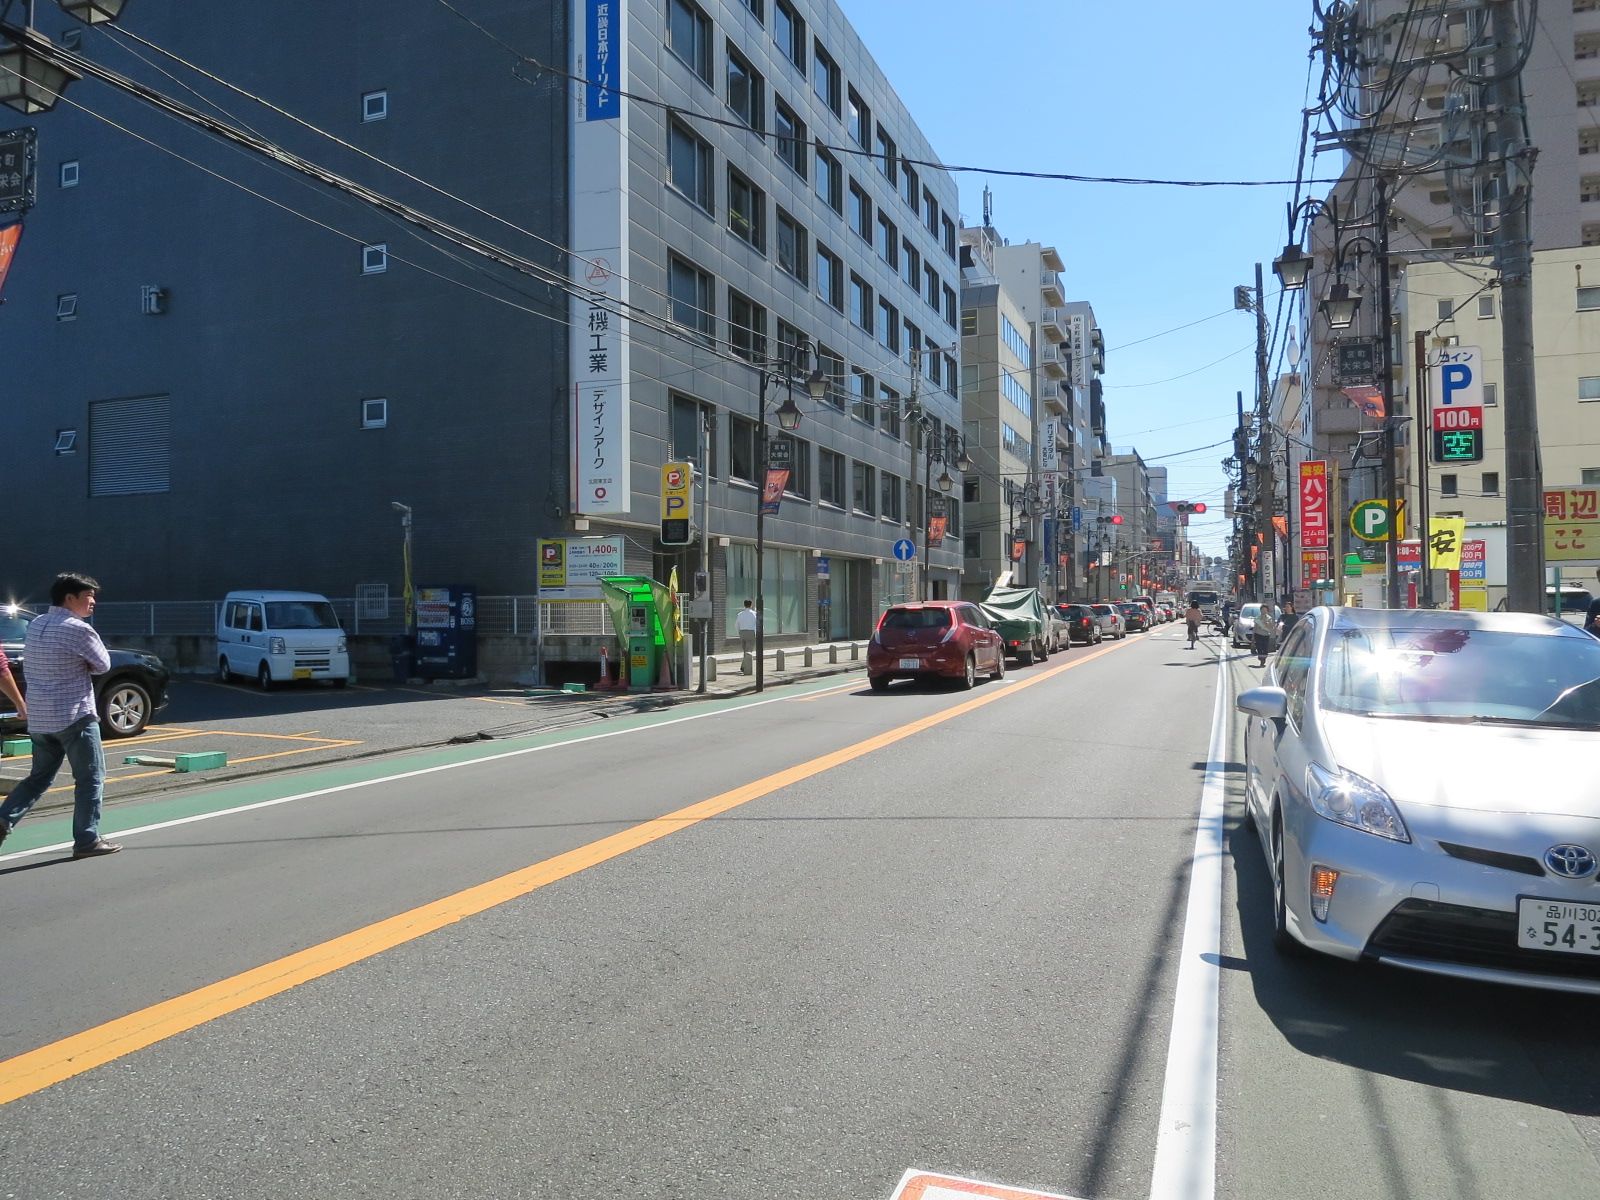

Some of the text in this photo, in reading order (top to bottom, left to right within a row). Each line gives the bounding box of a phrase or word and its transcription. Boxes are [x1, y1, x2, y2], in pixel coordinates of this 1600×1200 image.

[597, 3, 609, 108] 近畿日本ツーリスト
[588, 290, 608, 373] 三機工業
[1441, 363, 1472, 405] P
[593, 389, 607, 470] デザインアーク
[1436, 409, 1479, 428] 100円
[1443, 431, 1473, 458] 空
[666, 497, 685, 517] P
[1303, 478, 1323, 527] ハンコ
[1542, 490, 1598, 520] 周辺
[1364, 508, 1386, 534] P
[1554, 528, 1585, 550] ここ
